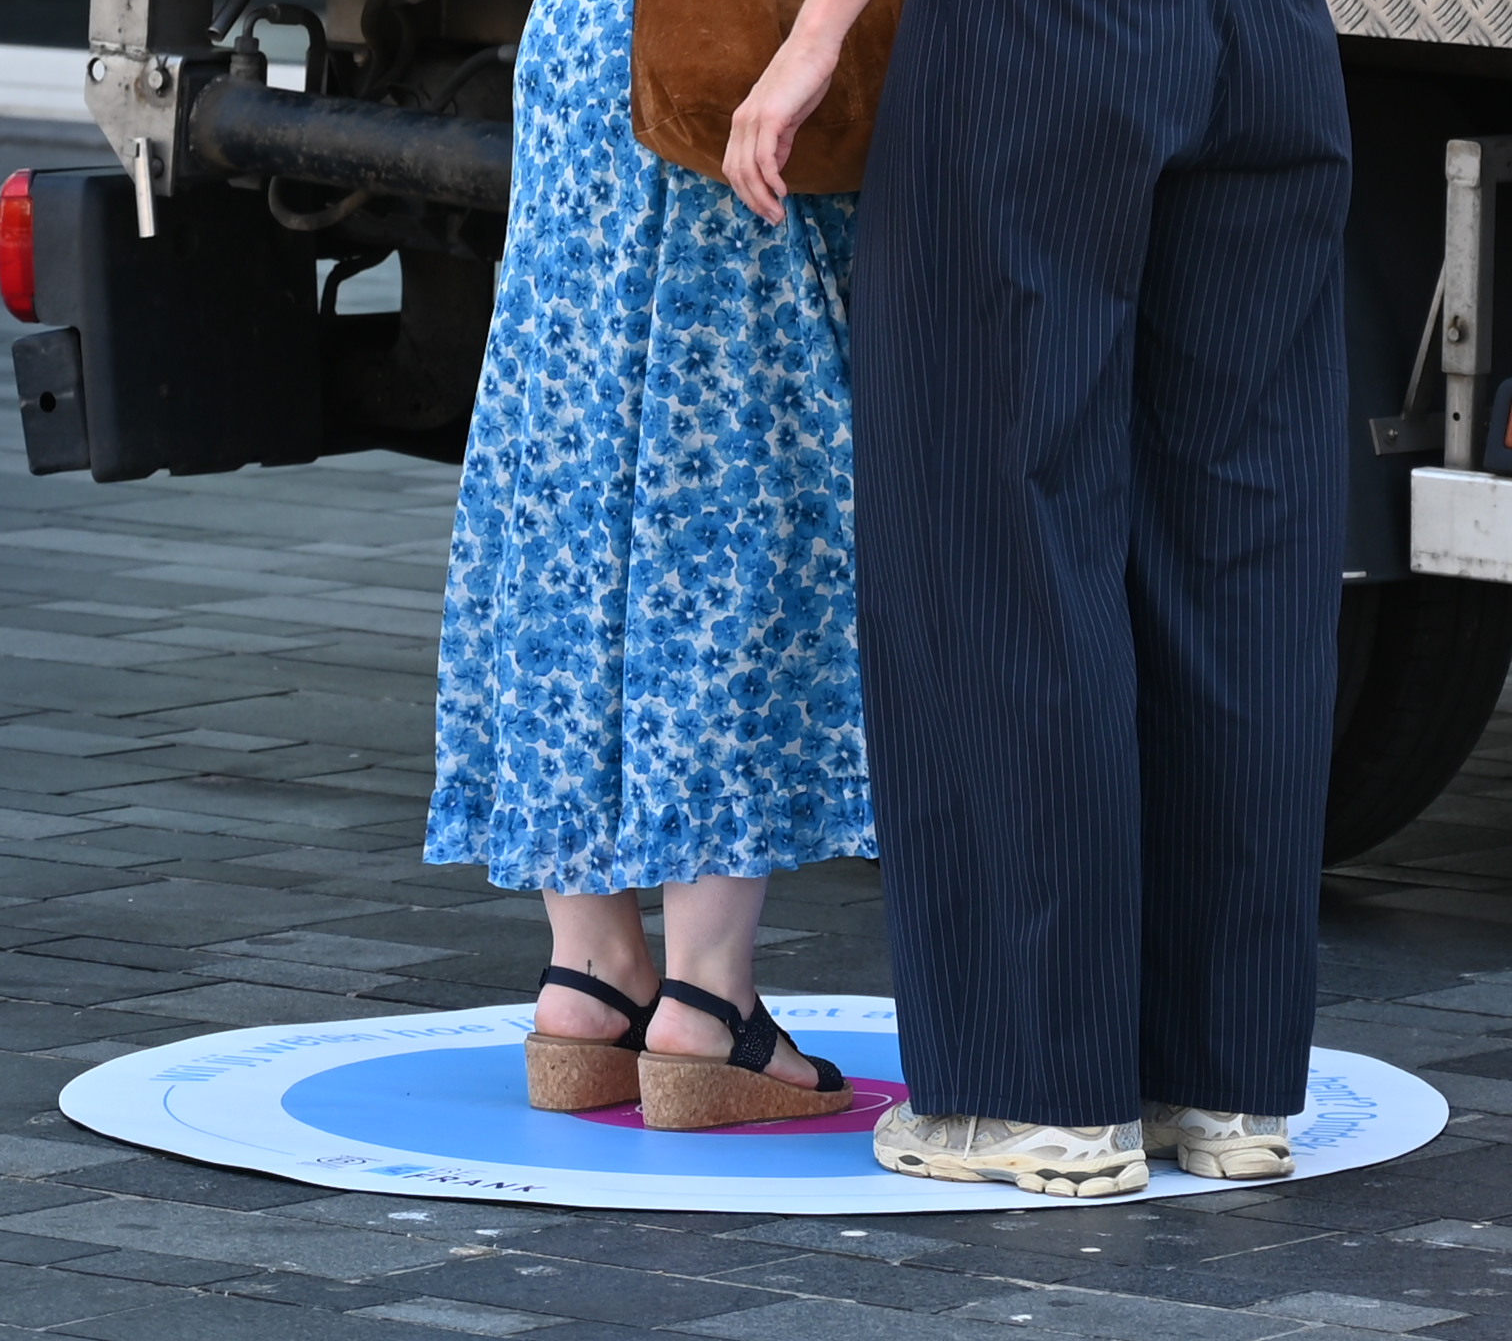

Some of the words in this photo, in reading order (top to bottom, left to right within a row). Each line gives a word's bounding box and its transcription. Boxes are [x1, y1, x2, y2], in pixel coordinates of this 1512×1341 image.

[149, 1065, 231, 1082] Wil
[241, 1032, 390, 1065] weten
[382, 1023, 495, 1040] hoe
